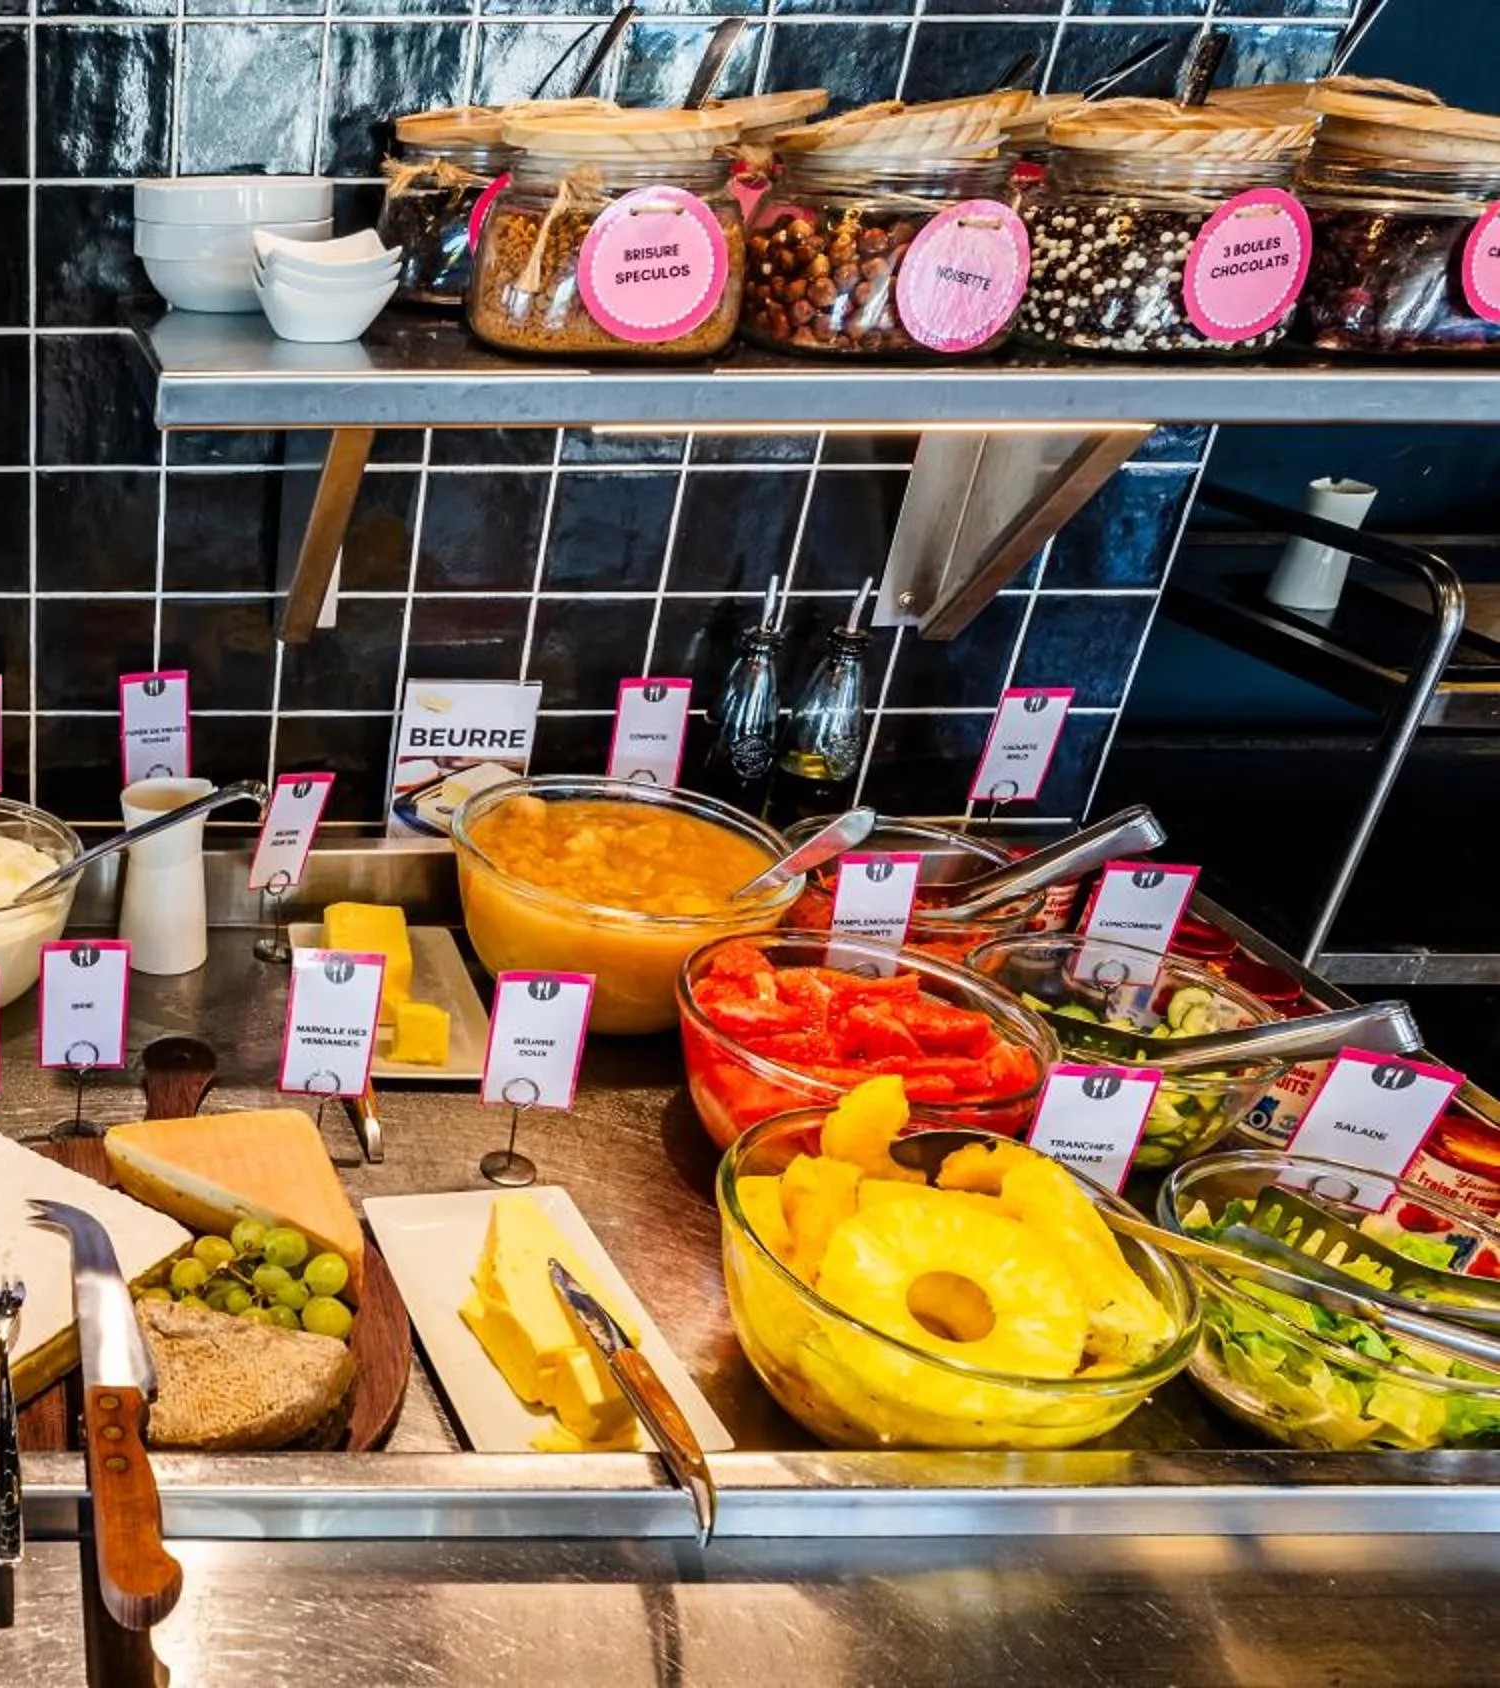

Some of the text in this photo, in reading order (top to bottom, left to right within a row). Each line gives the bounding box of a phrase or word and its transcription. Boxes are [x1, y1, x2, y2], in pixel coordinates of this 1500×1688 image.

[624, 244, 681, 262] BRISURE
[1223, 237, 1281, 259] 3 BOULES
[615, 264, 691, 285] SPECULOS
[1210, 254, 1290, 279] CHOCOLATS
[936, 265, 993, 291] NOISETTE
[409, 727, 527, 748] BEURRE
[296, 1025, 368, 1036] MAROILLE DES
[301, 1037, 361, 1047] VENDANGES
[513, 1037, 556, 1047] BEURRE
[519, 1049, 547, 1057] DOUX
[1333, 1121, 1389, 1141] SALADE
[1050, 1139, 1115, 1151] TRANCHES
[1053, 1151, 1103, 1162] ANANAS
